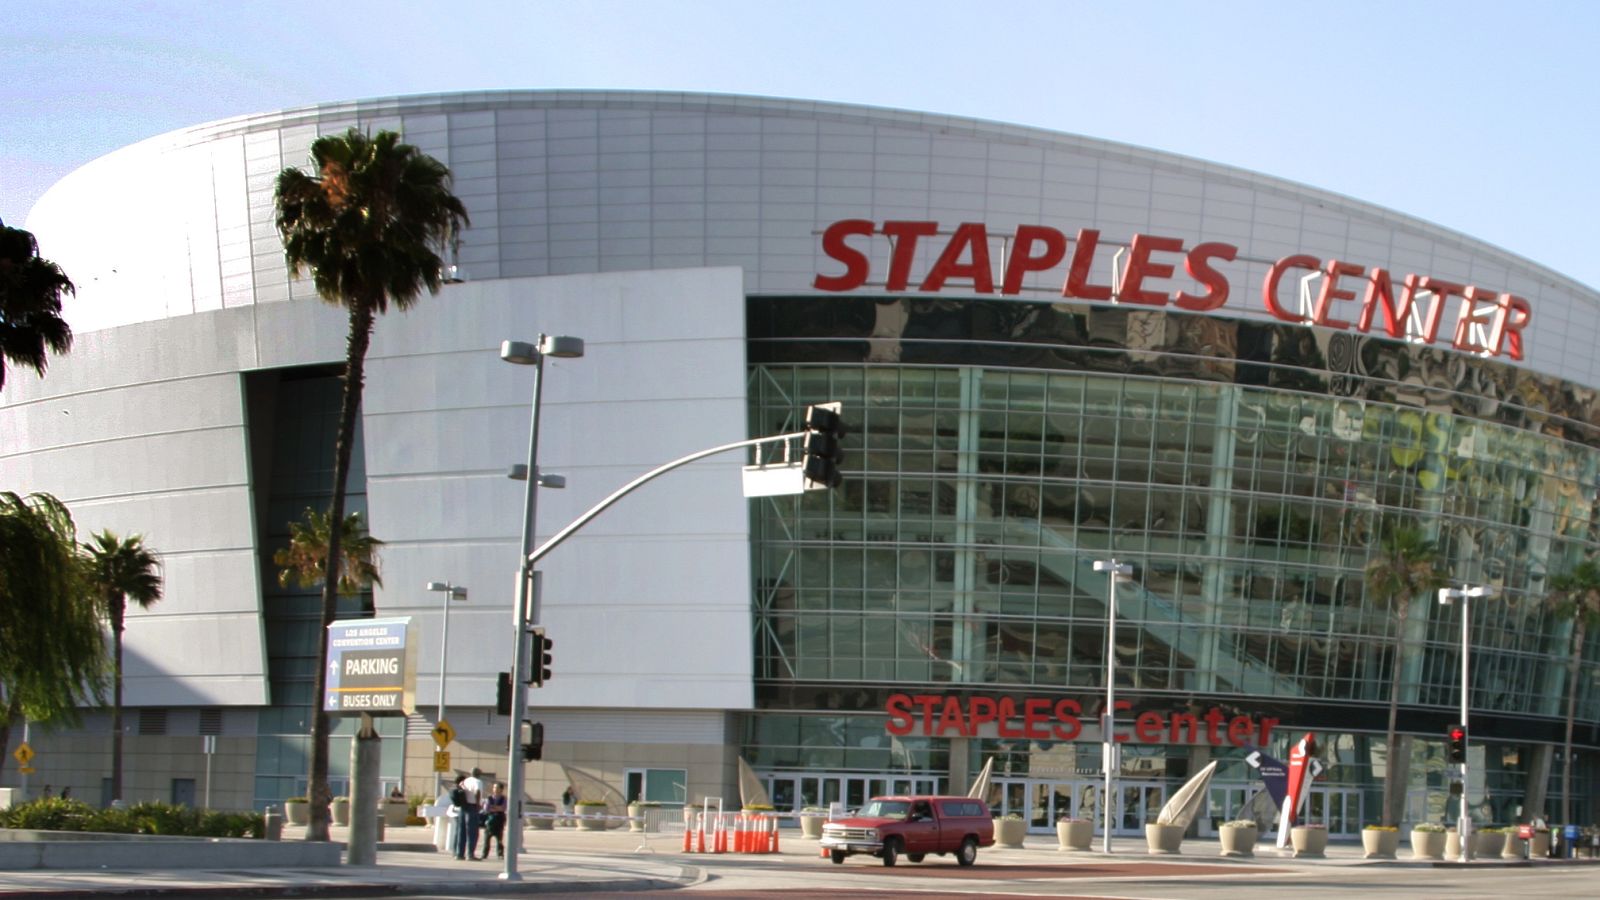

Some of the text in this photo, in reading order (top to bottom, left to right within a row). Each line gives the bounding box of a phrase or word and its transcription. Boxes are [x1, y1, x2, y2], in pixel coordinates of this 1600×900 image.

[814, 219, 1532, 361] STAPLES CENTER
[345, 657, 398, 676] PARKING
[343, 694, 397, 707] BUSES ONLY
[885, 693, 1279, 747] STAPLES Center
